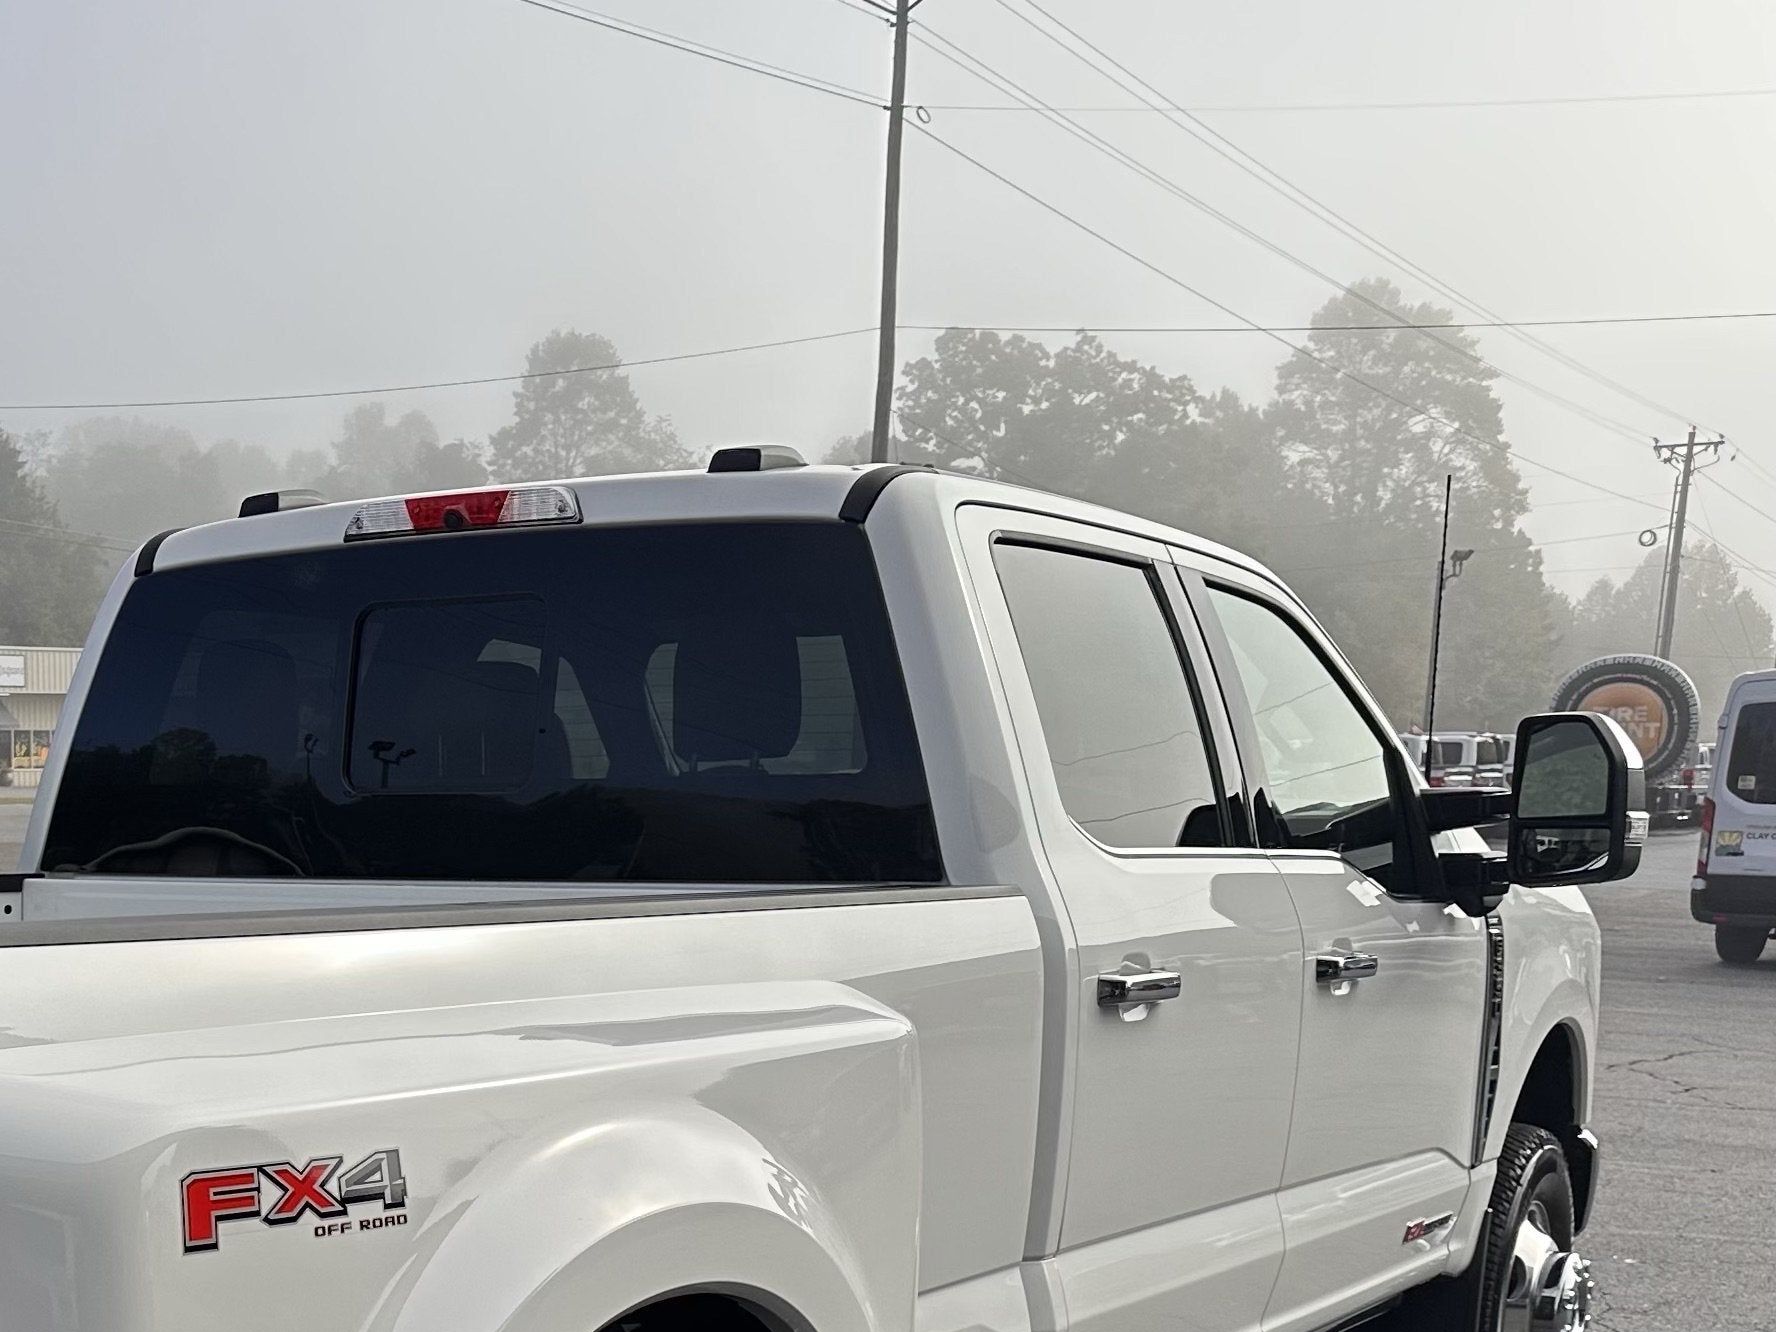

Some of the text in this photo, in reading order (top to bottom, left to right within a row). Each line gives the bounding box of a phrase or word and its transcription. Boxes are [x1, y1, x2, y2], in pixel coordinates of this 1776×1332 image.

[1746, 832, 1769, 840] CLAY
[180, 1147, 408, 1256] FX4
[314, 1213, 408, 1238] OFF ROAD
